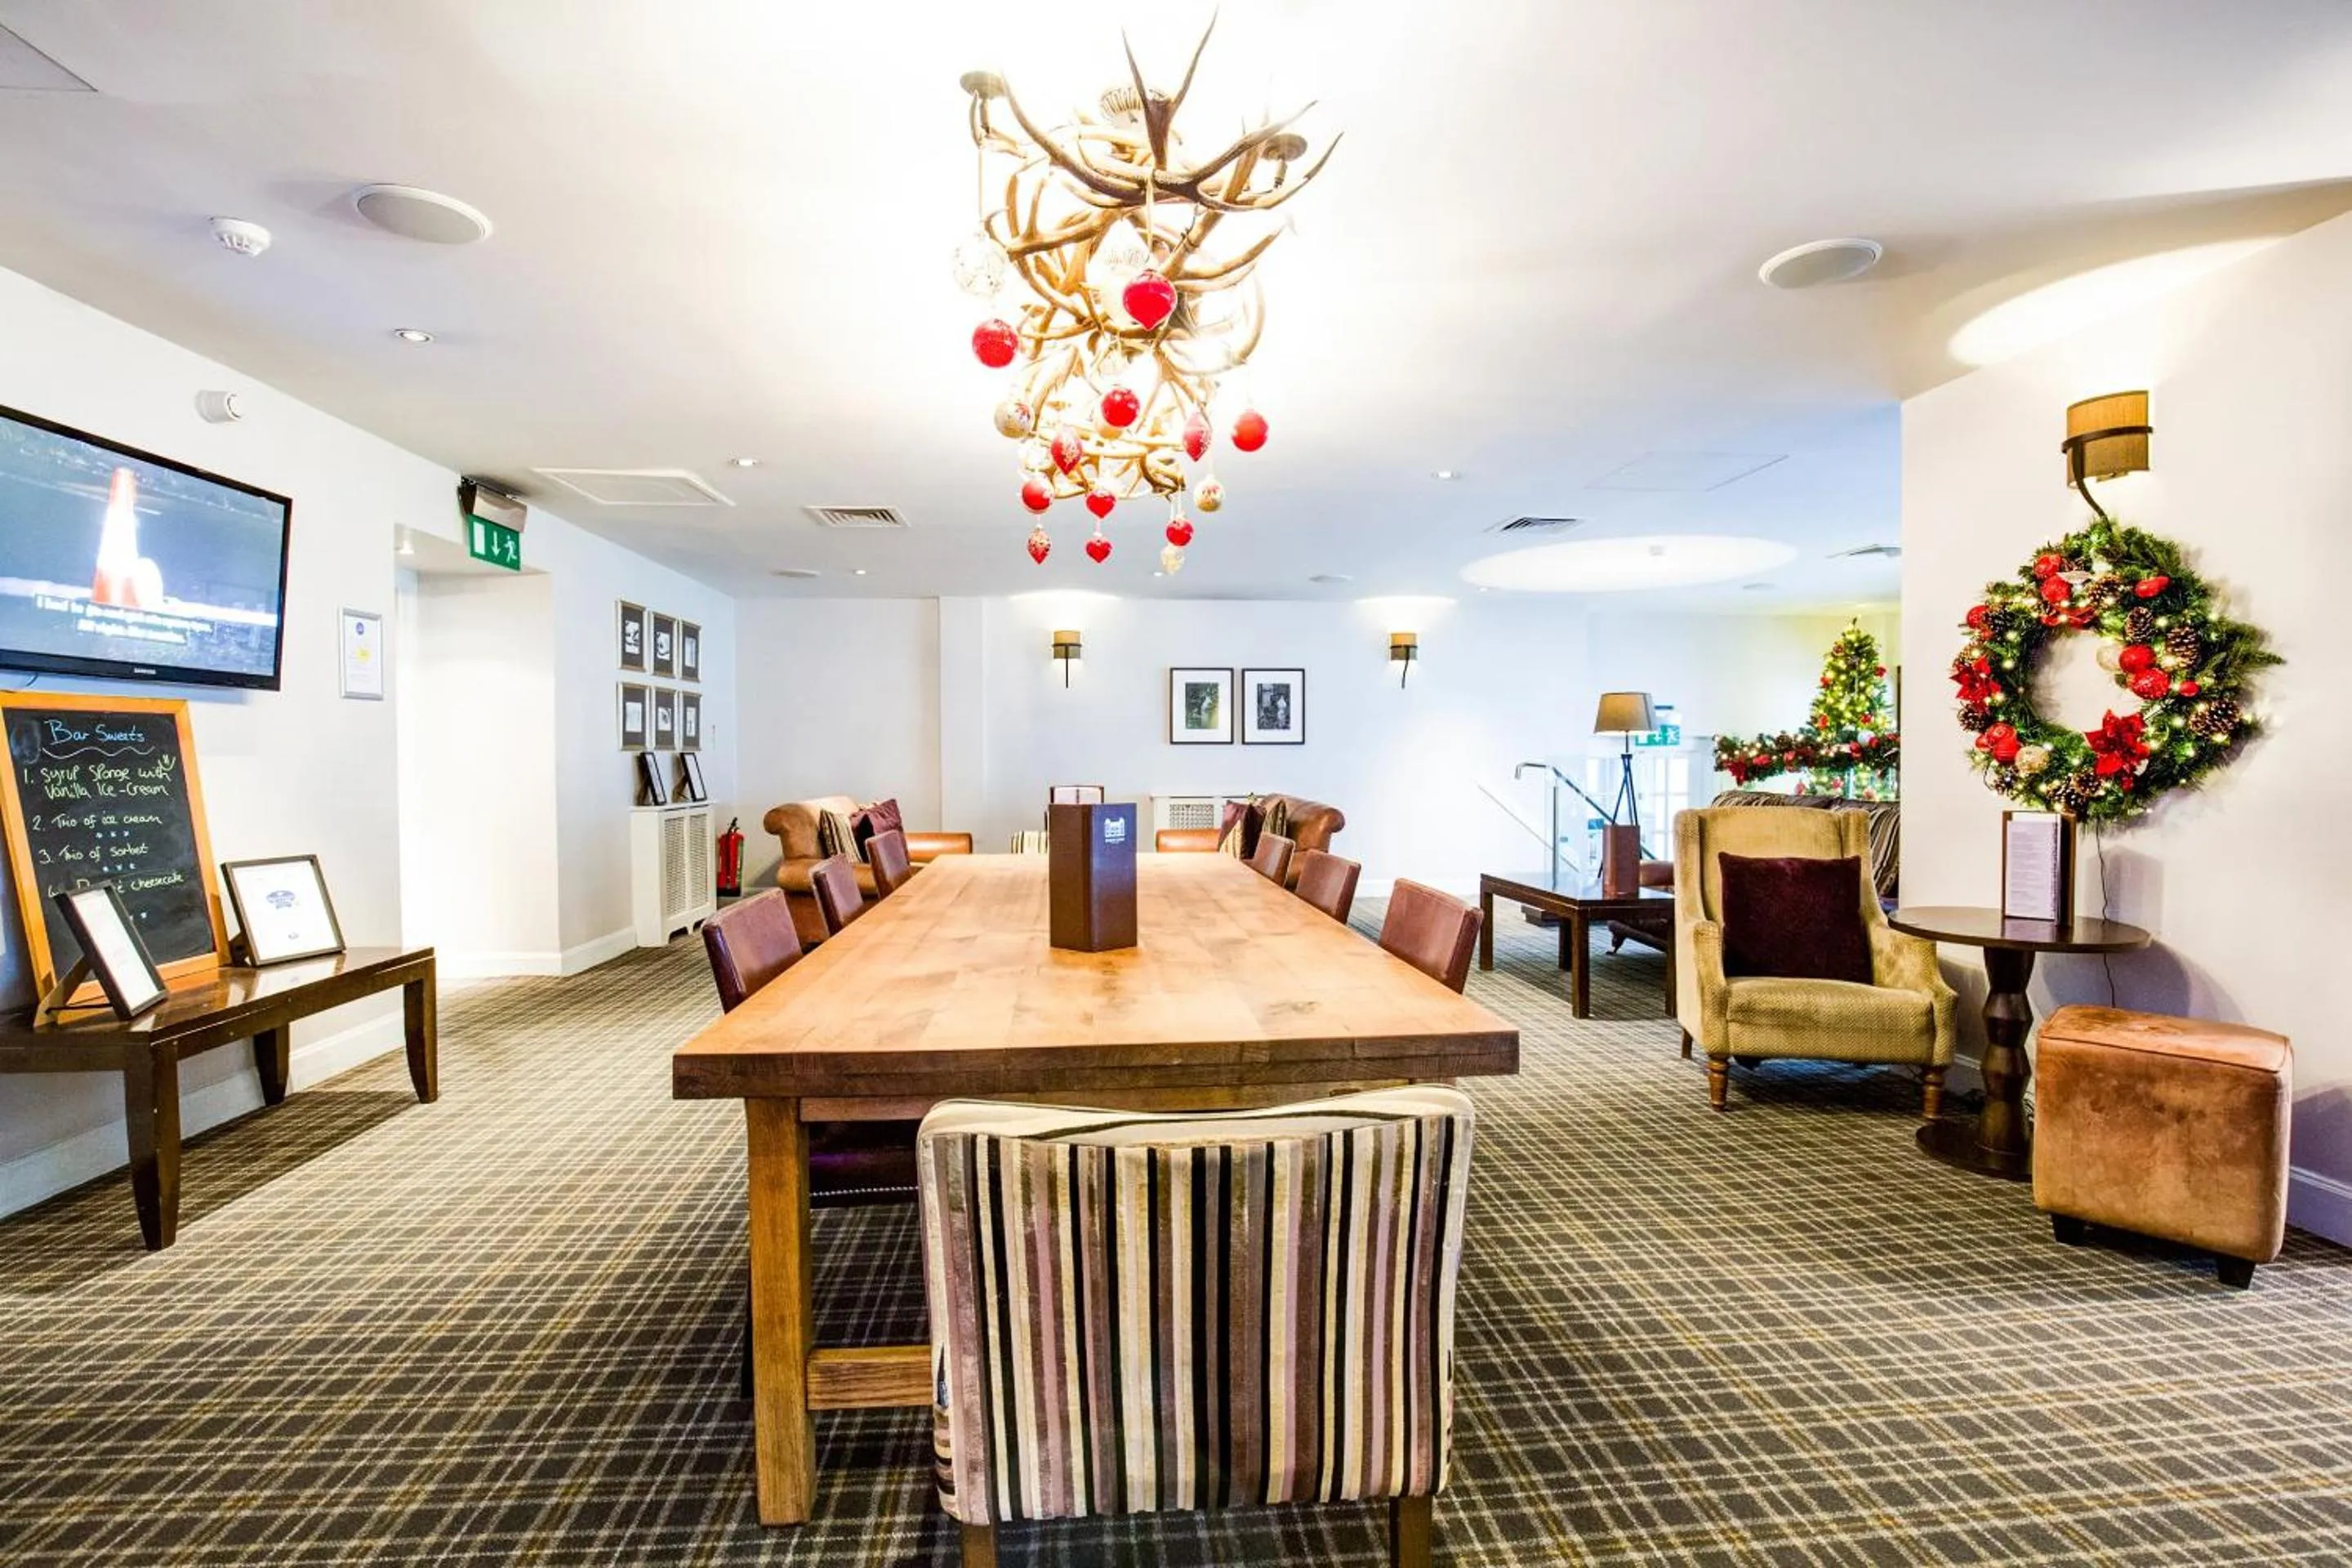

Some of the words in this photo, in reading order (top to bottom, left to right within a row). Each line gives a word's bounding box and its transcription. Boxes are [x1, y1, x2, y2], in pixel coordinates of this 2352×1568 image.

[44, 719, 90, 745] Bar
[95, 724, 145, 742] Sweets
[44, 782, 92, 800] Vanilla
[51, 813, 78, 829] Trio
[83, 814, 97, 829] of
[58, 844, 84, 861] Trio
[88, 845, 101, 863] of
